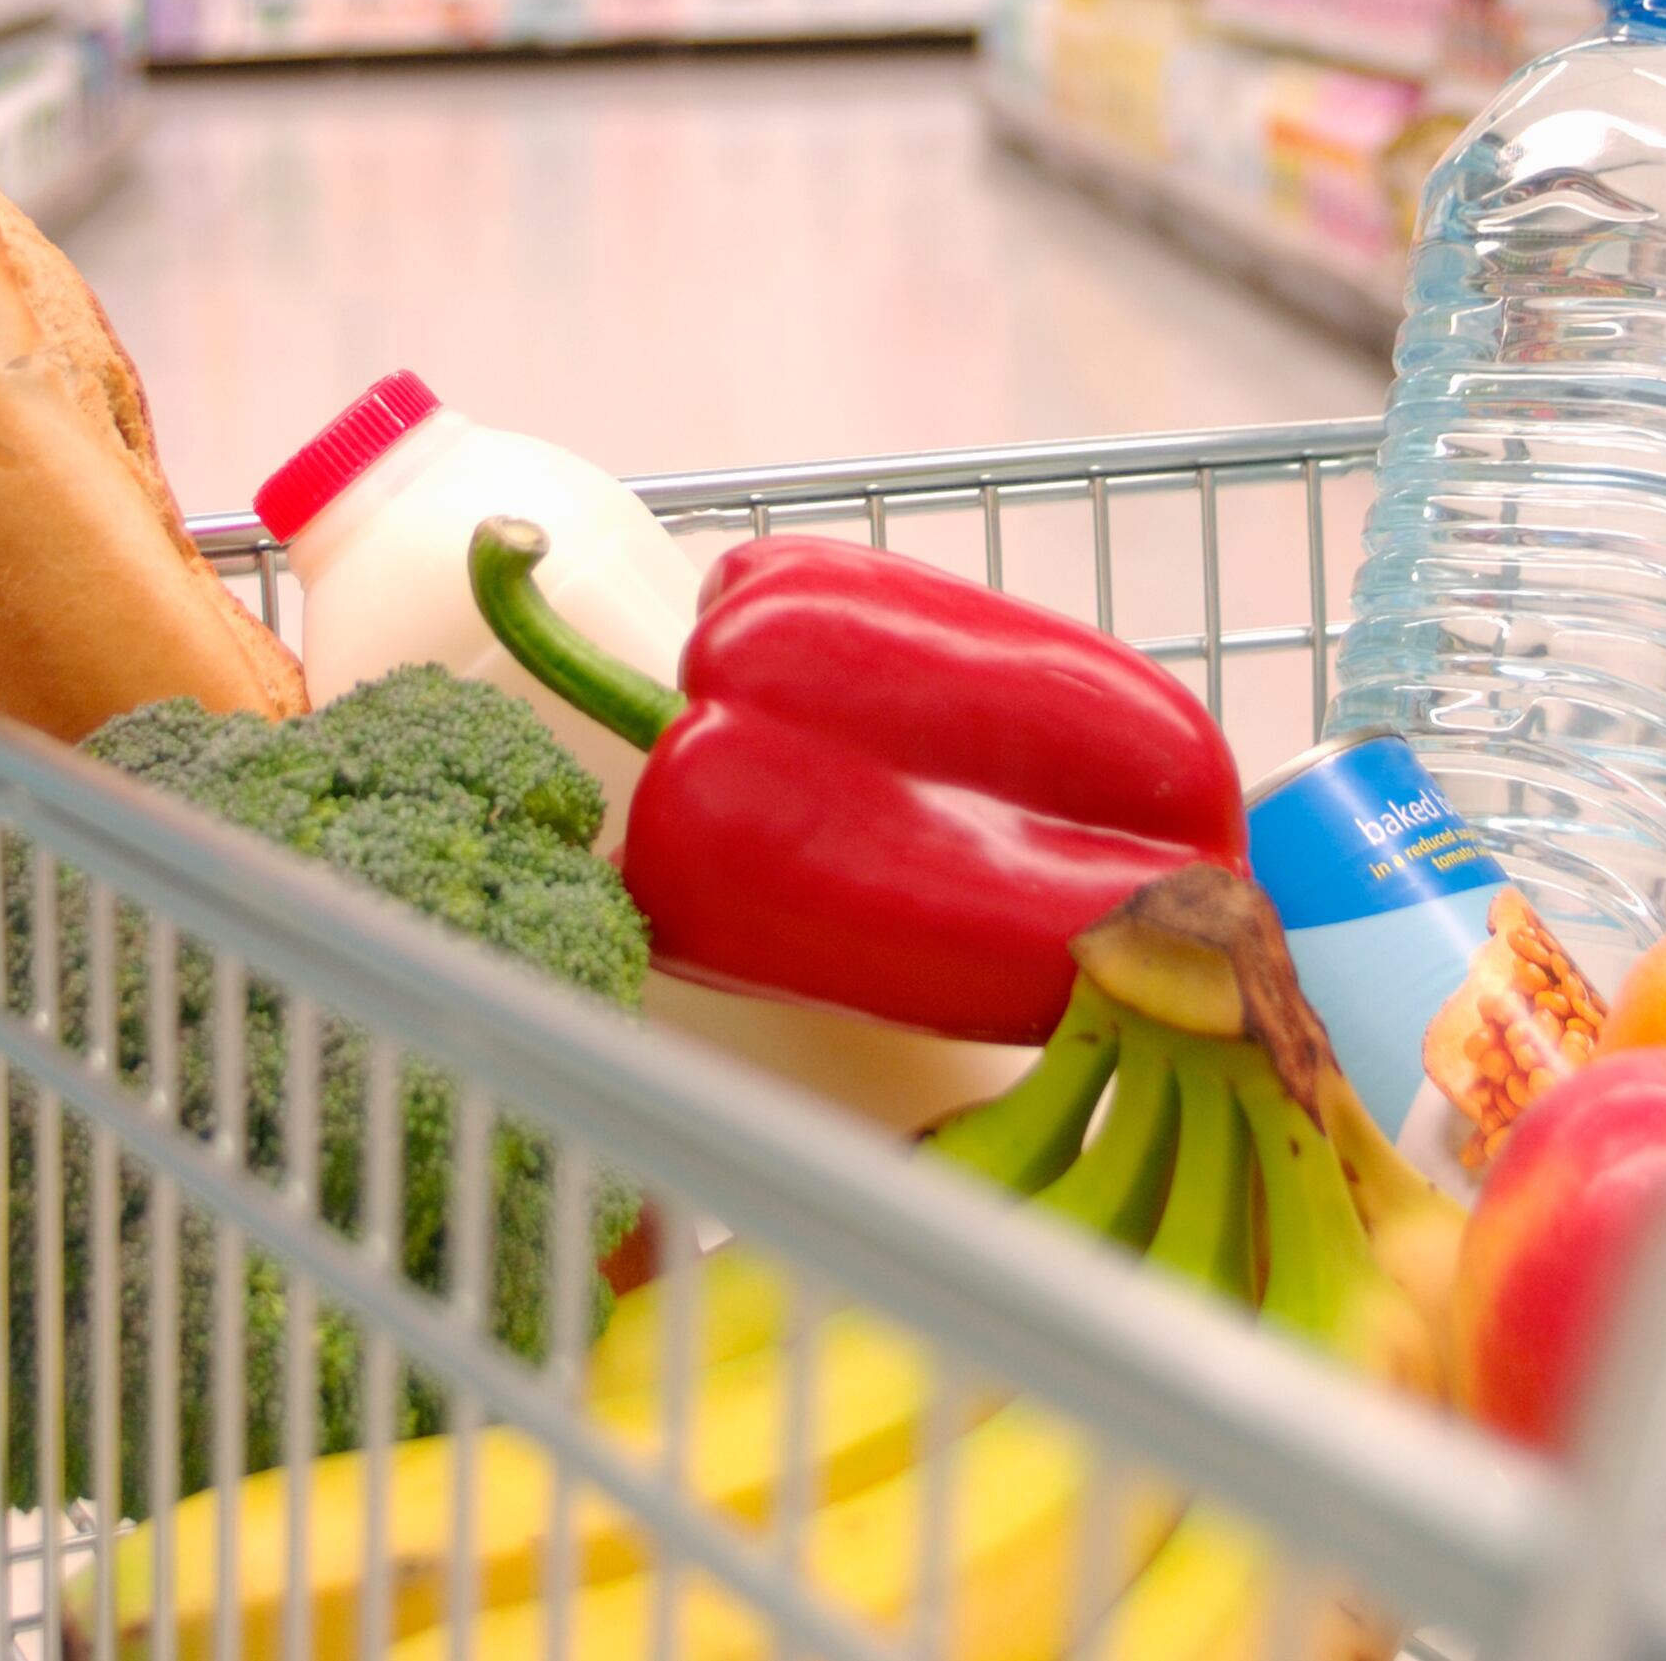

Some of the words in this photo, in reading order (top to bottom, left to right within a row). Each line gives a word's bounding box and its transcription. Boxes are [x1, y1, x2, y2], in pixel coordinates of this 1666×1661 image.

[1354, 789, 1441, 846] baked
[1369, 861, 1392, 880] in
[1391, 853, 1406, 868] a
[1404, 827, 1458, 860] reduced
[1431, 846, 1477, 871] tomato
